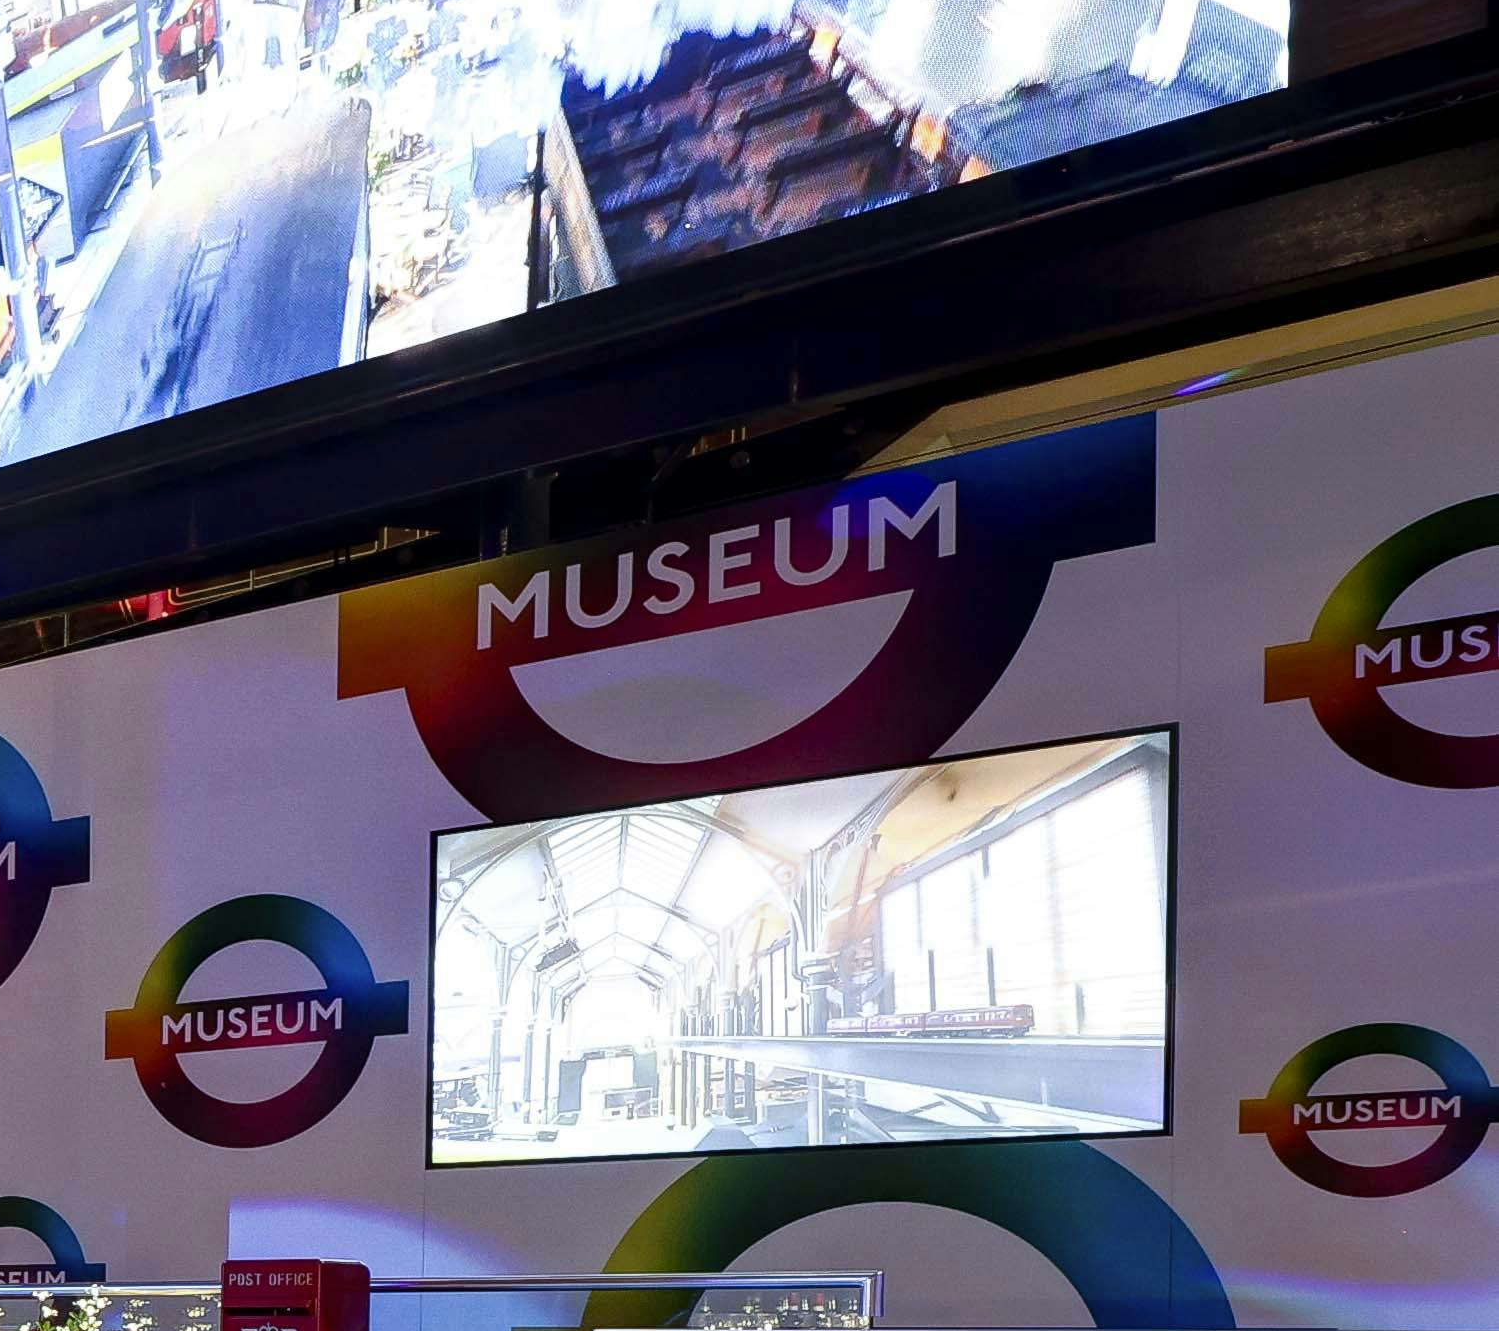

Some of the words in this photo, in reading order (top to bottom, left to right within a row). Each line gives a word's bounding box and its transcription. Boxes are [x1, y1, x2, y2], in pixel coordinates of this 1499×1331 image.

[476, 480, 957, 651] MUSEUM
[1355, 625, 1498, 679] MUS
[160, 997, 343, 1046] MUSEUM
[1293, 1095, 1461, 1125] MUSEUM
[229, 1273, 261, 1286] POST
[269, 1273, 313, 1286] OFFICE
